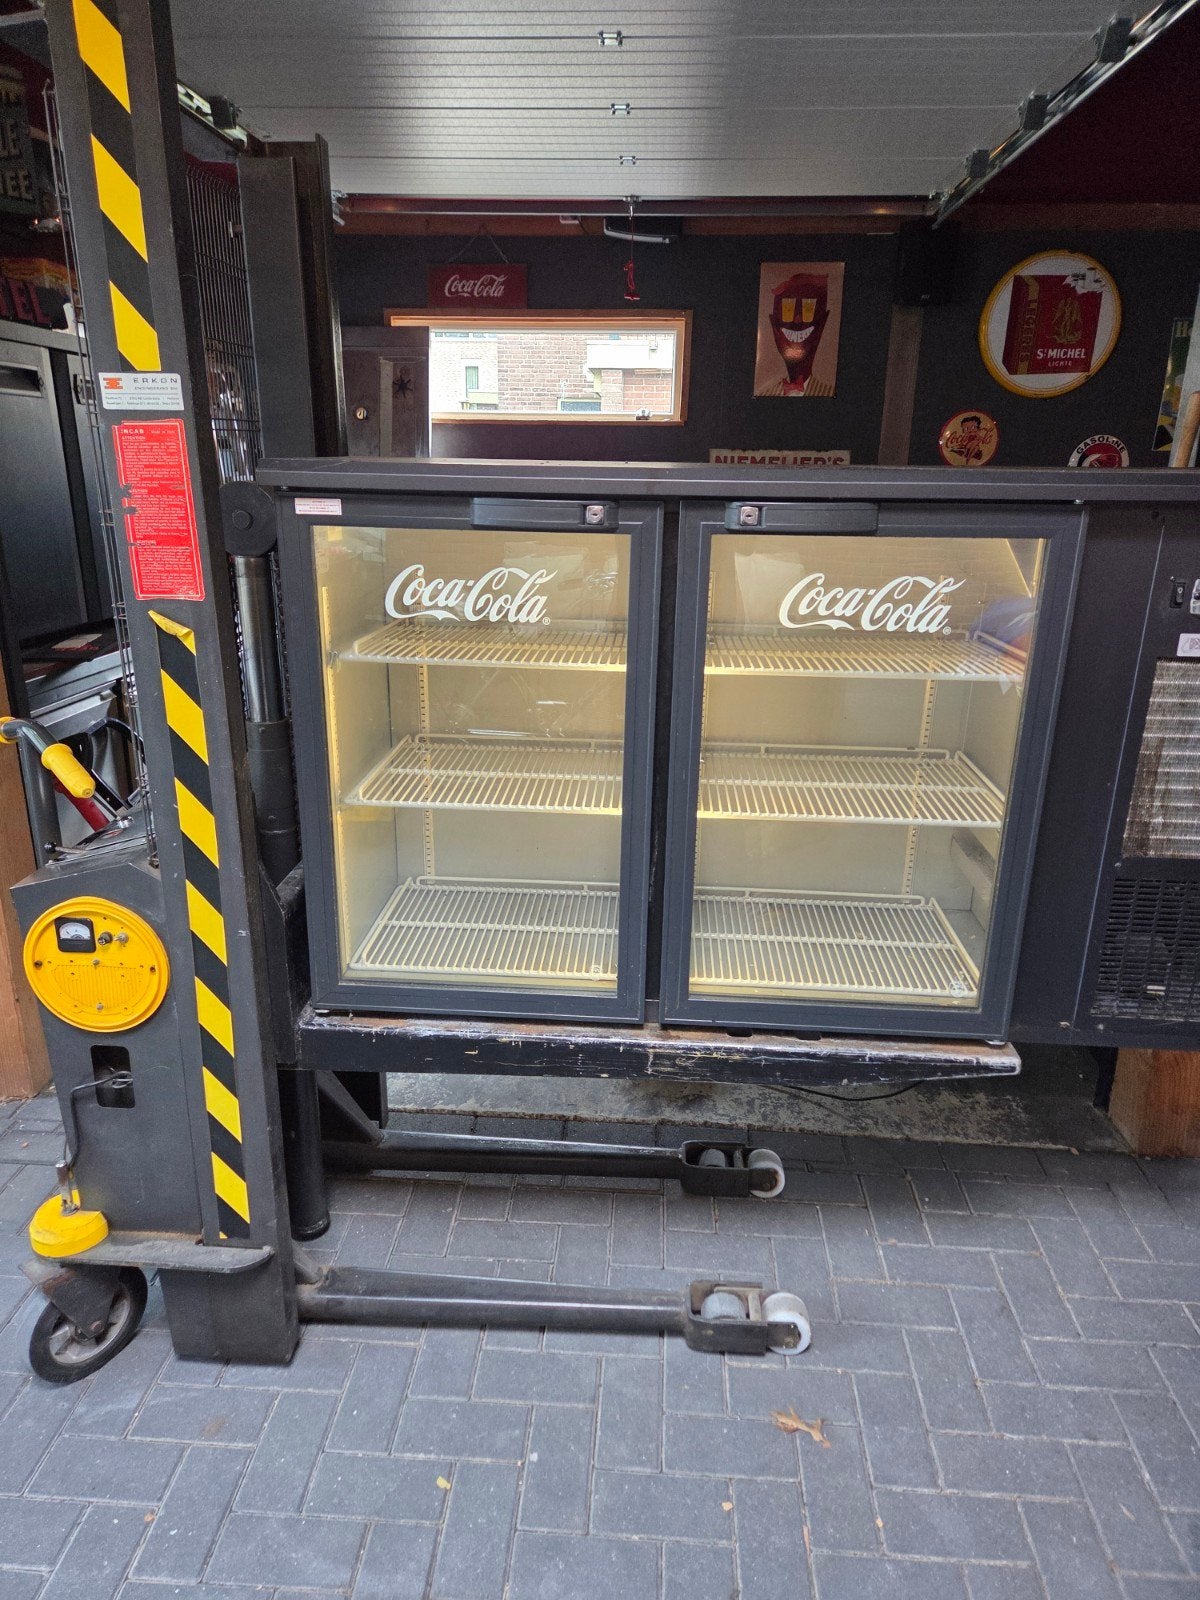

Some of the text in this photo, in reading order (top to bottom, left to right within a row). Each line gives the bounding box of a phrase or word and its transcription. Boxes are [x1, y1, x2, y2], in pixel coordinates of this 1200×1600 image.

[443, 273, 509, 299] Coca-Cola
[384, 563, 558, 624] Coca-Cola
[778, 572, 967, 634] Coca-Cola
